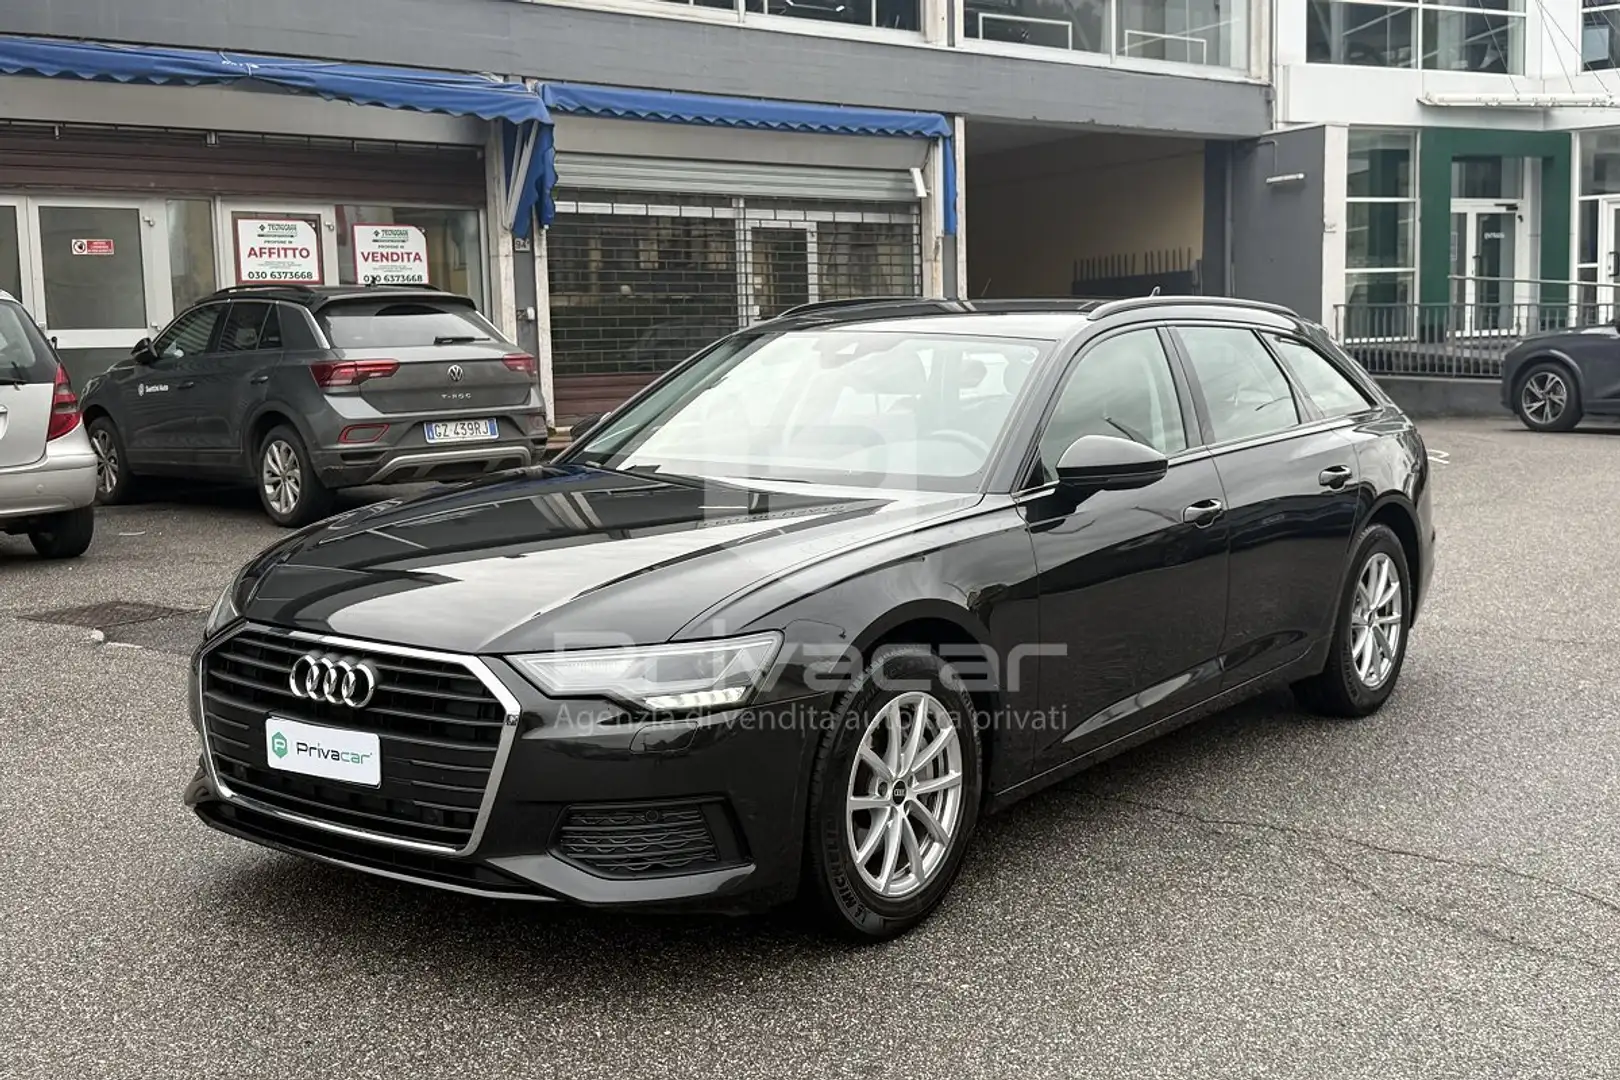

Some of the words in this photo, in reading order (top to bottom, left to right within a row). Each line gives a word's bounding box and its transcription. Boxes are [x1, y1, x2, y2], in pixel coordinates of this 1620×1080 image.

[247, 246, 310, 259] AFFITTO
[361, 251, 422, 263] VENDITA
[247, 271, 267, 280] 030
[269, 271, 313, 280] 6373668
[383, 274, 423, 283] 6373668
[434, 422, 450, 438] GZ
[453, 419, 489, 437] 439RJ
[296, 741, 371, 764] Privacar
